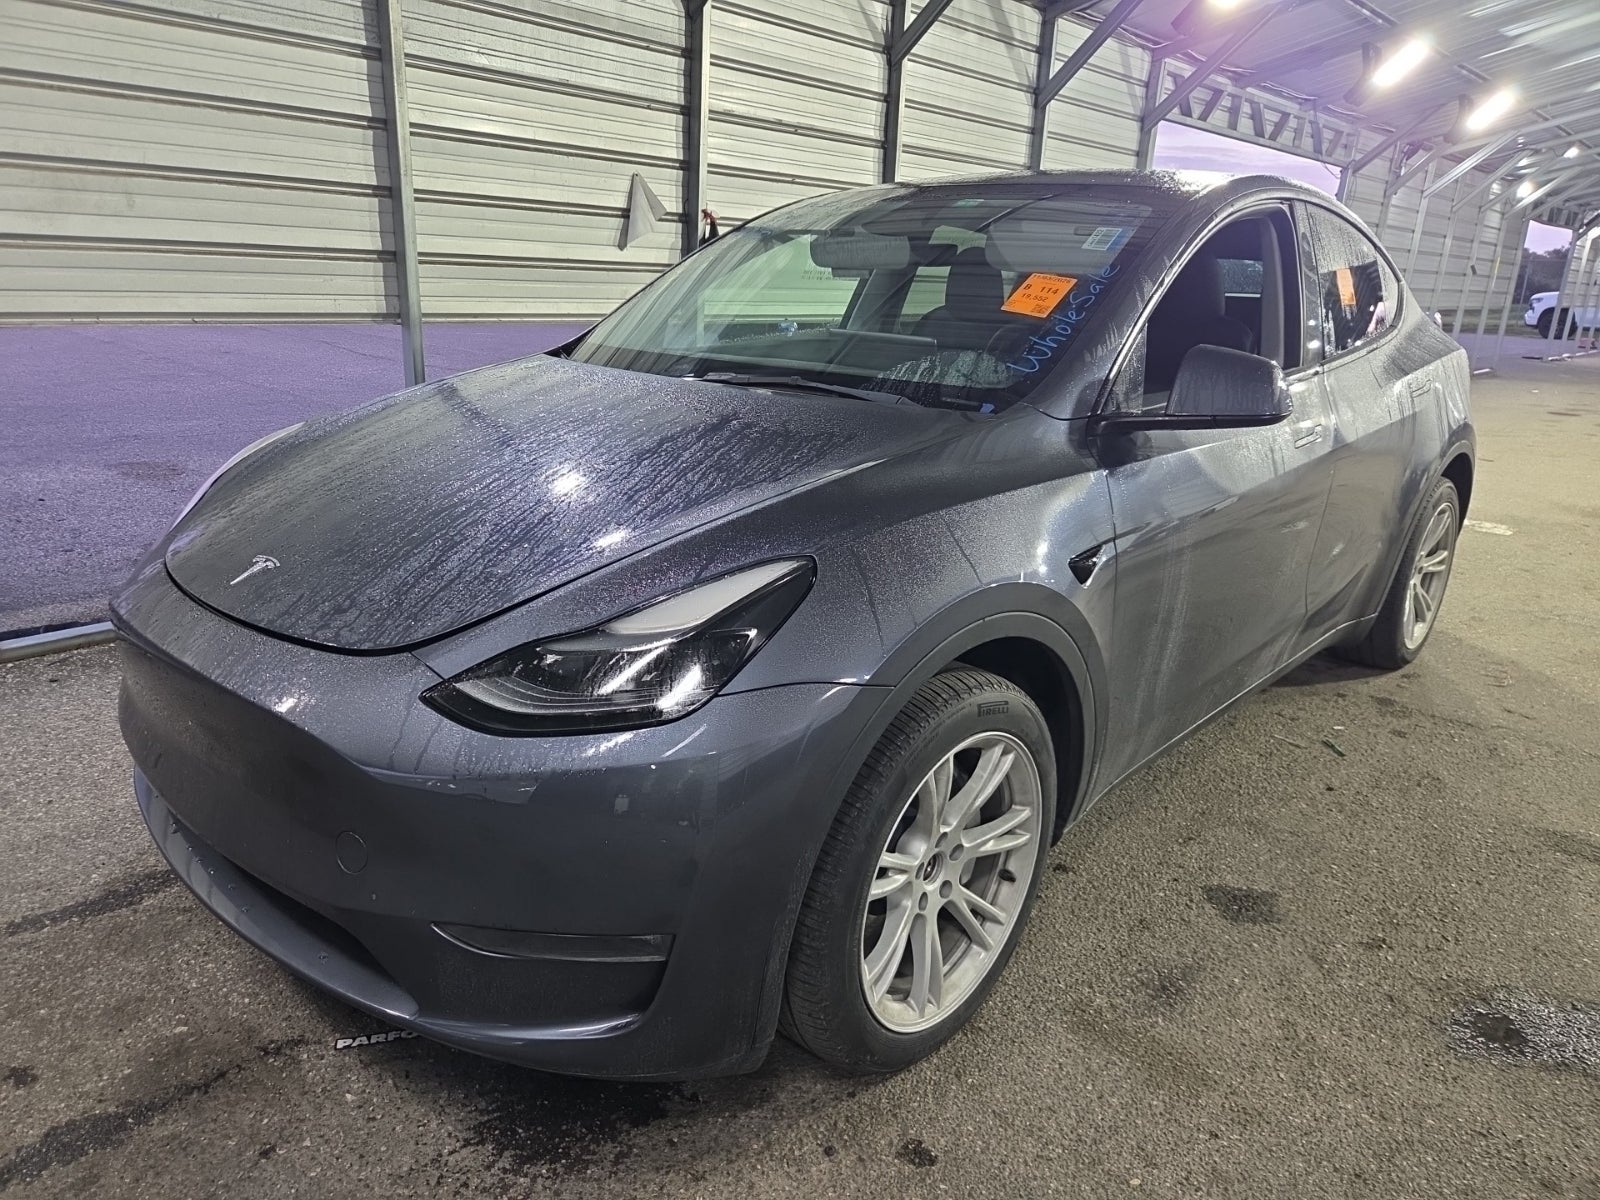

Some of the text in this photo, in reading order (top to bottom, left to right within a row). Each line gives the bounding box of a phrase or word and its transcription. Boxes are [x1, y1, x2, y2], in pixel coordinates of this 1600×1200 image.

[1023, 283, 1059, 295] B 114
[1021, 292, 1049, 303] 19,552
[977, 700, 1009, 717] PIRELLI
